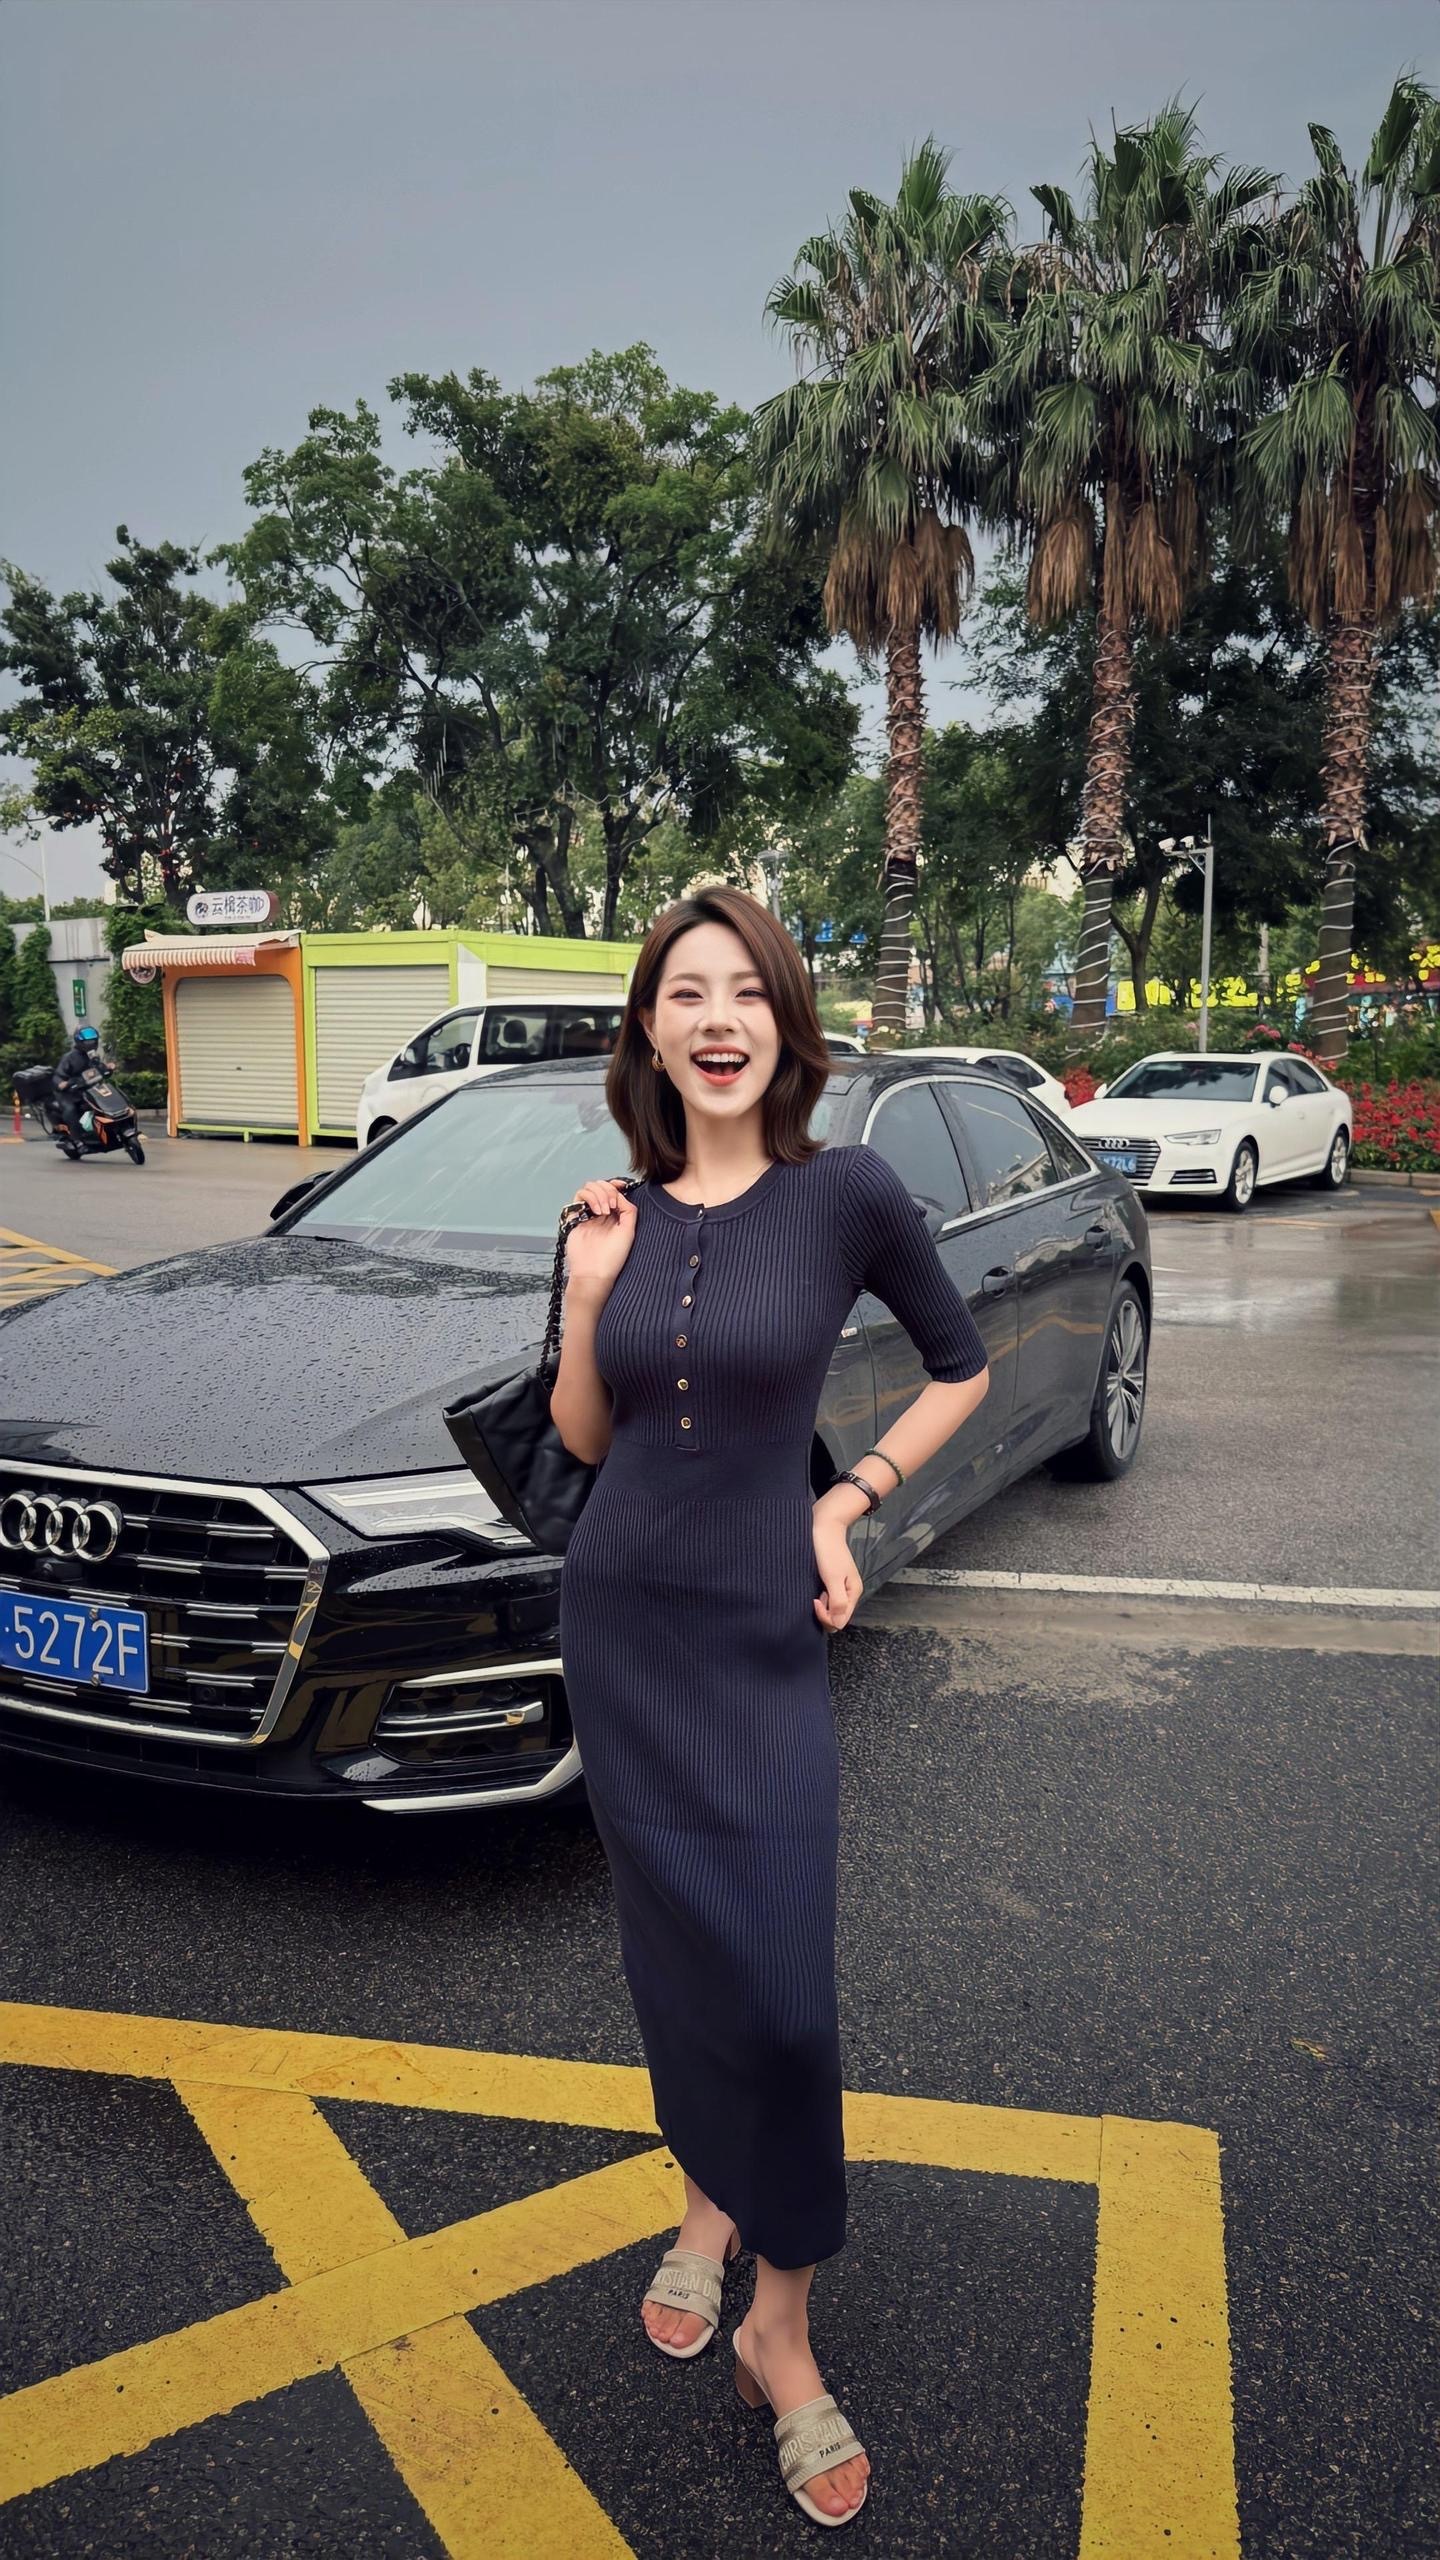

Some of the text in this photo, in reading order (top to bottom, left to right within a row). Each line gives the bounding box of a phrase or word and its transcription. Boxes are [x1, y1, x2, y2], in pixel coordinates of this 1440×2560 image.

[14, 1605, 140, 1676] 5272F
[668, 2288, 690, 2300] PARIS
[819, 2442, 841, 2459] PARIS
